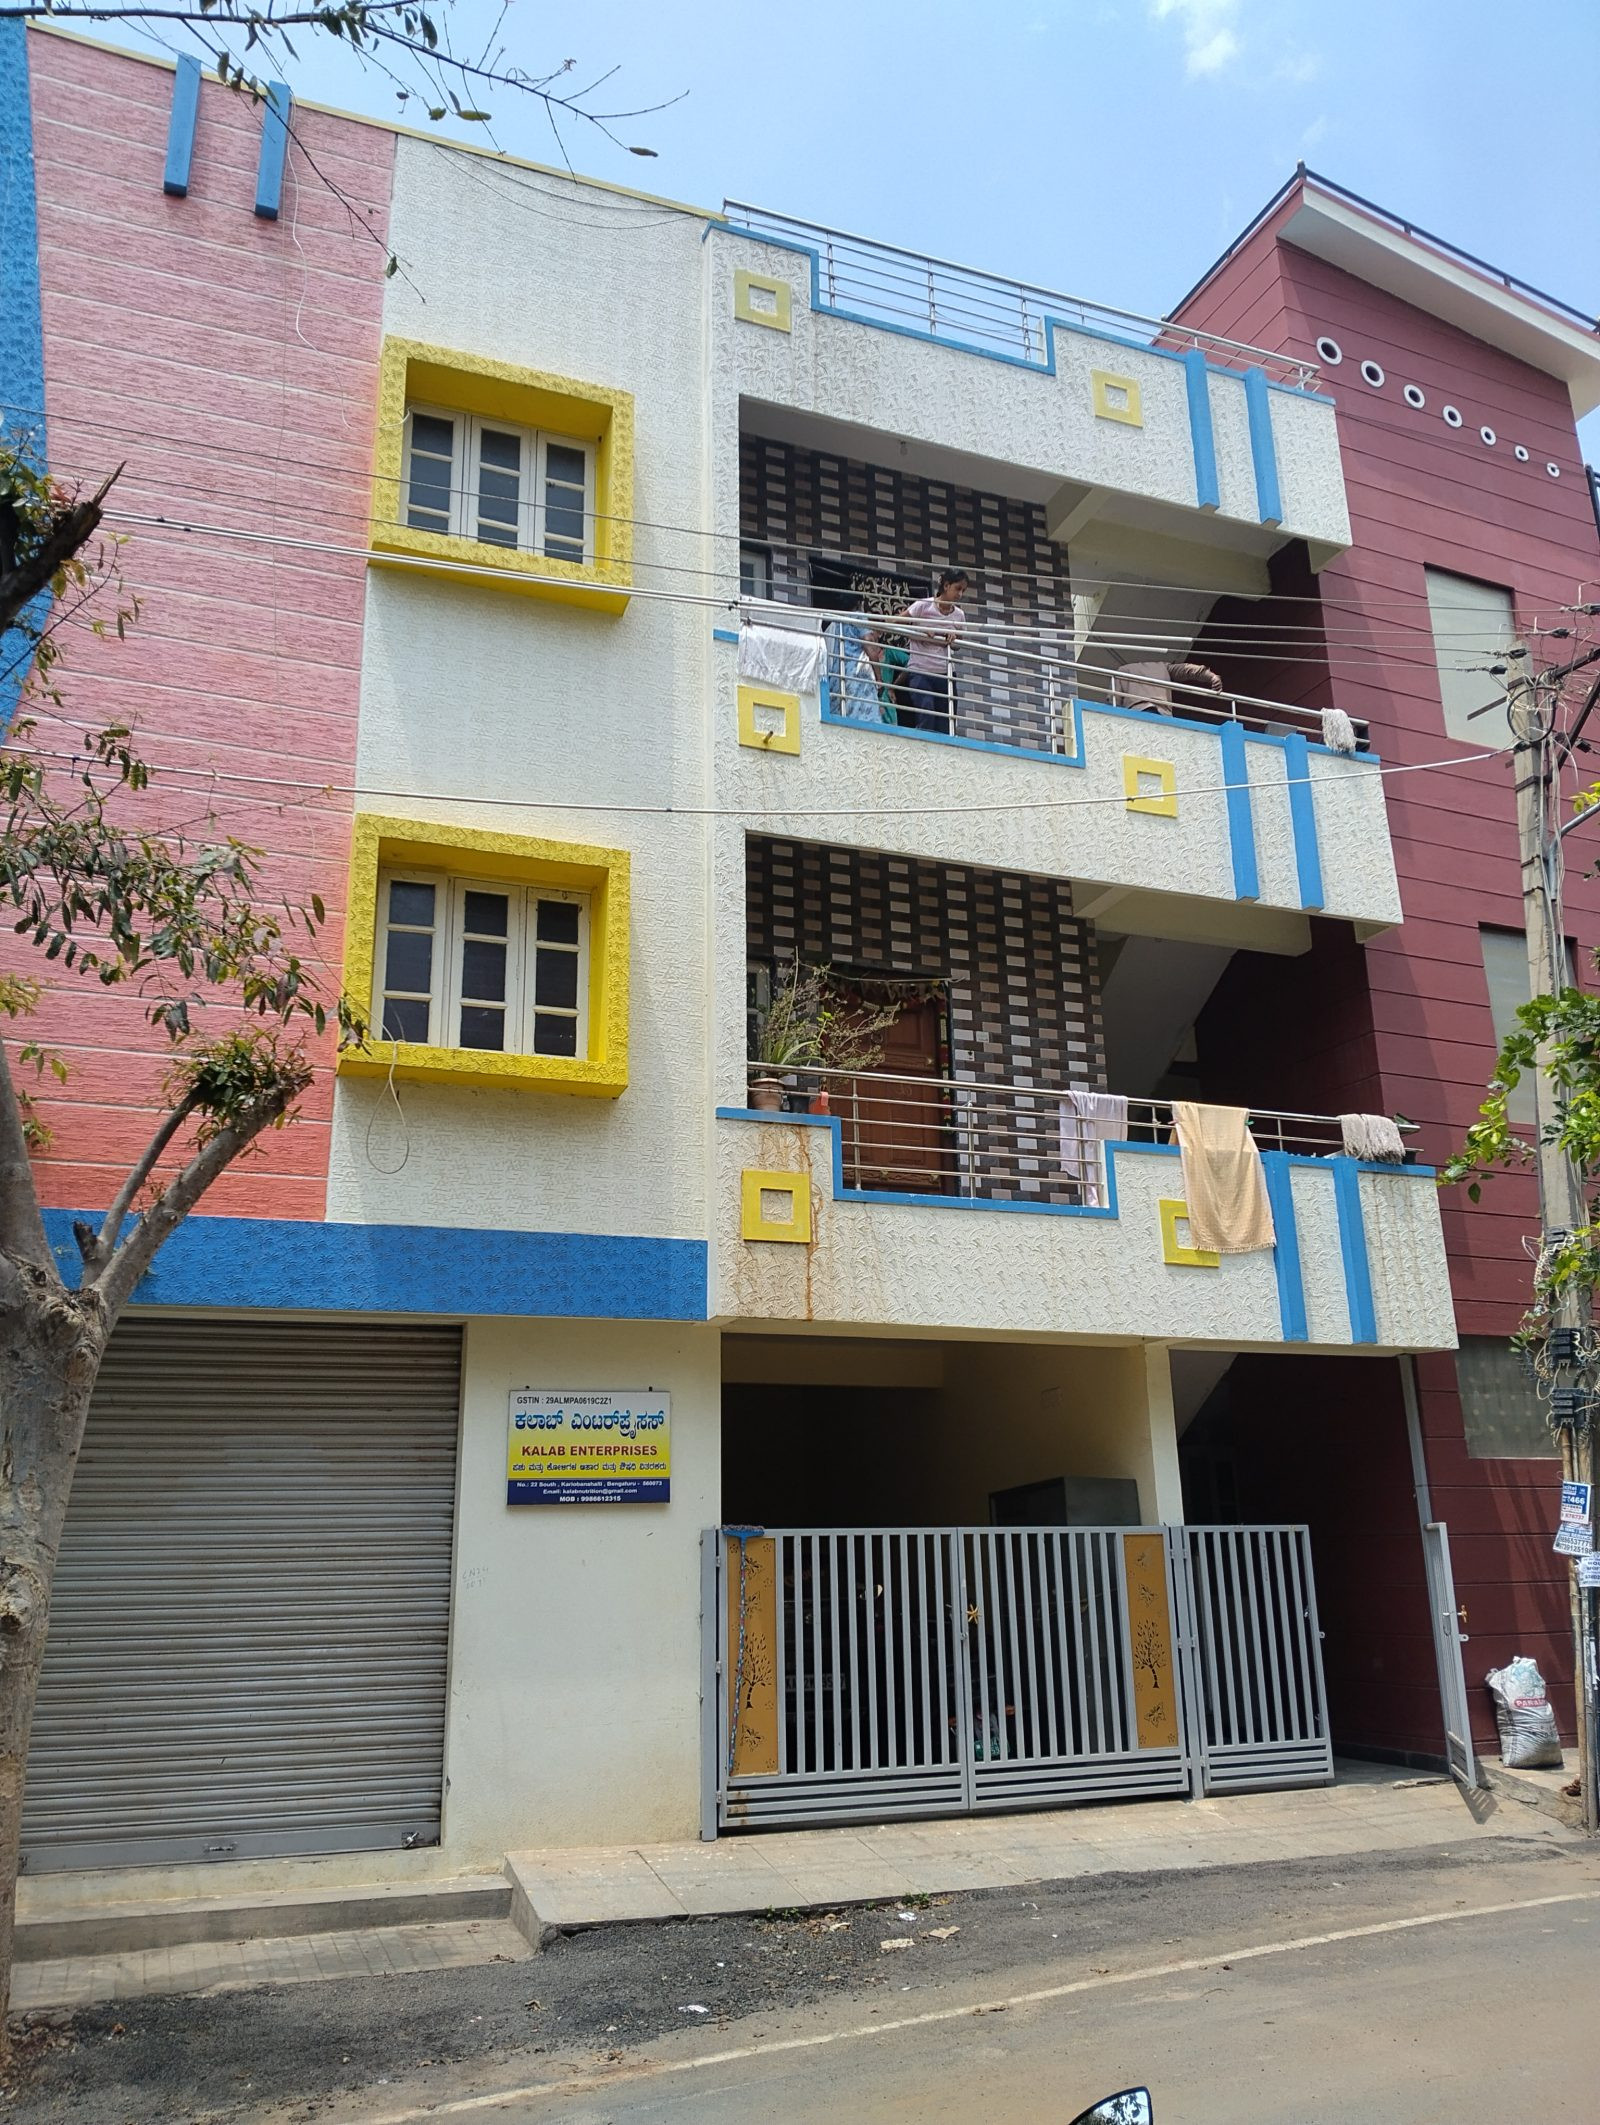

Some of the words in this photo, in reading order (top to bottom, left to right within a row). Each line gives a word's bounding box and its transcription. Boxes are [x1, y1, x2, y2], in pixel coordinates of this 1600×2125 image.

[517, 1396, 540, 1404] GSTIN
[515, 1409, 563, 1430] ಕಲಾಬ್
[522, 1446, 566, 1456] KALAB
[570, 1445, 658, 1456] ENTERPRISES
